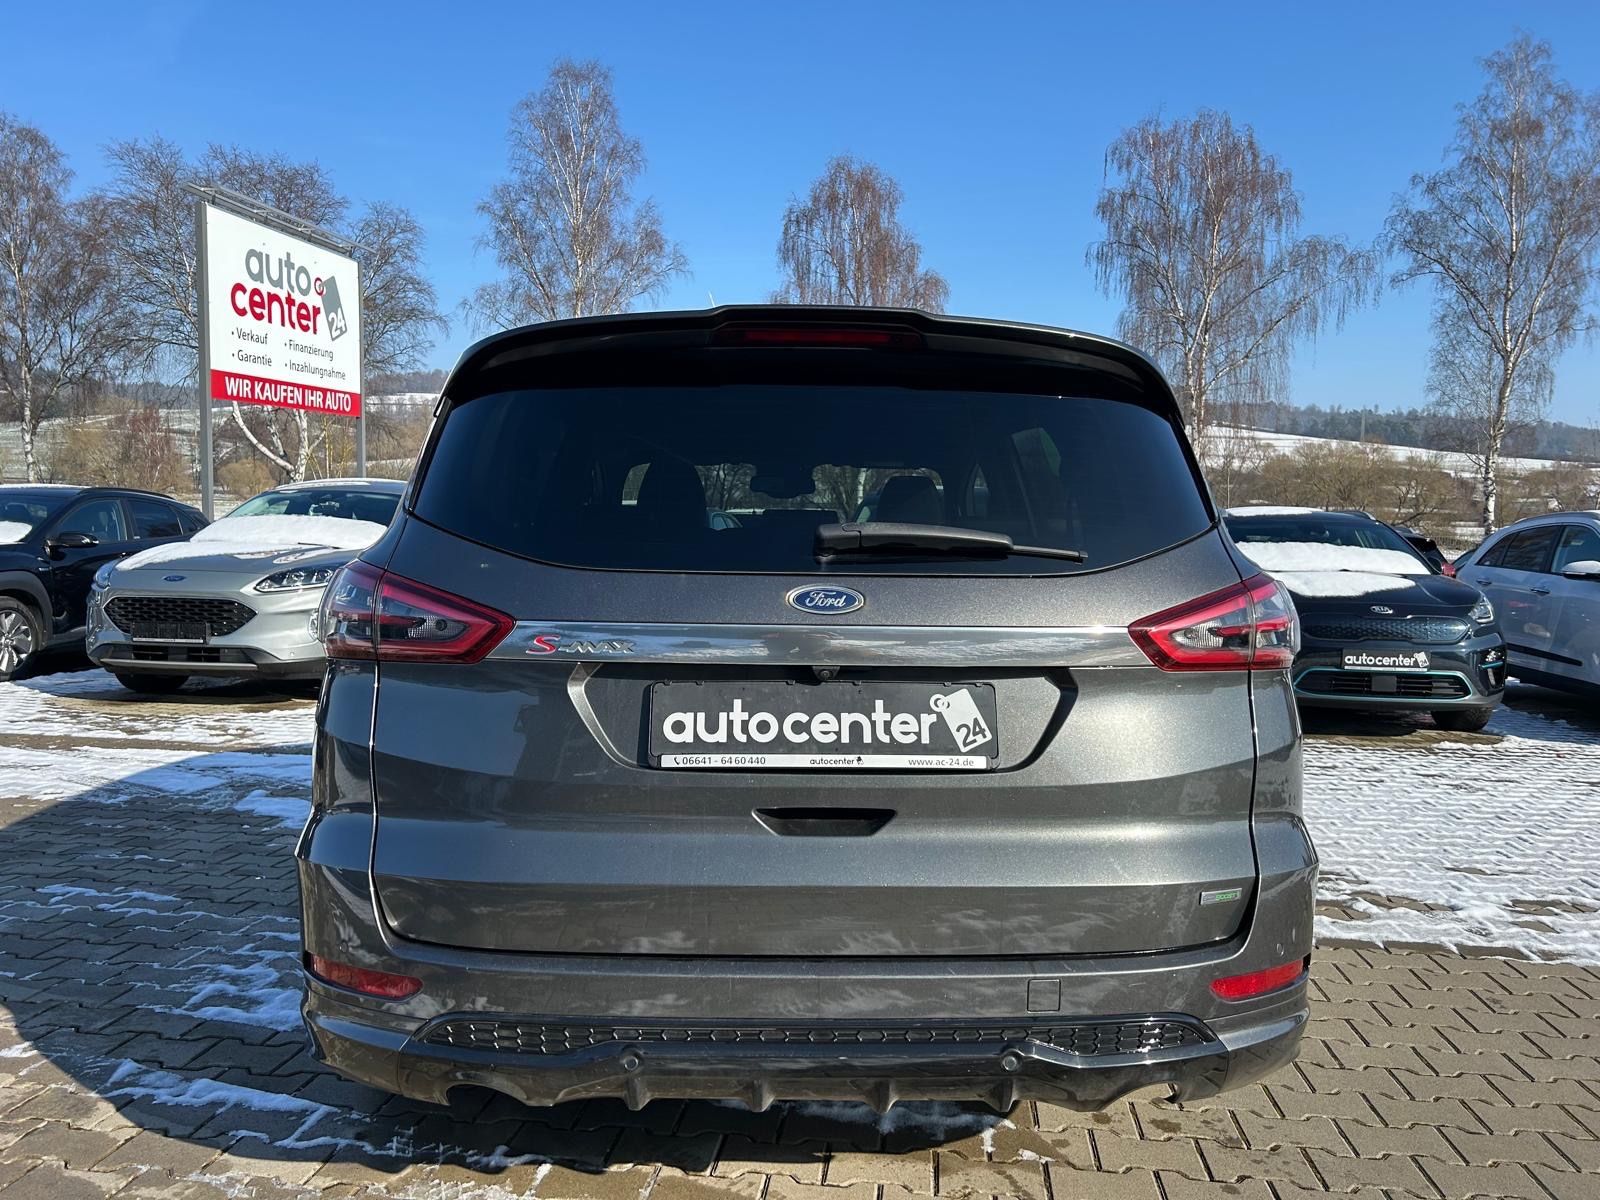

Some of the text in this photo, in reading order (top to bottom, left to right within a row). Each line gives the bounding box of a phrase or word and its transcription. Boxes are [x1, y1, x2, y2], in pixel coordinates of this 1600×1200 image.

[245, 249, 311, 296] auto
[230, 282, 321, 334] center
[328, 308, 345, 335] 24
[236, 327, 268, 345] Verkauf
[237, 349, 273, 367] Garantie
[289, 339, 334, 361] Finanzierung
[289, 359, 346, 380] Inzahlungnahme
[225, 376, 352, 412] WIR KAUFEN IHR AUTO
[805, 590, 847, 607] Ford
[1344, 653, 1416, 666] autocenter
[662, 698, 937, 744] autocenter
[956, 717, 987, 747] 24
[682, 756, 712, 765] 06641
[809, 757, 855, 765] autocenter
[908, 758, 975, 767] www.ac-24.de
